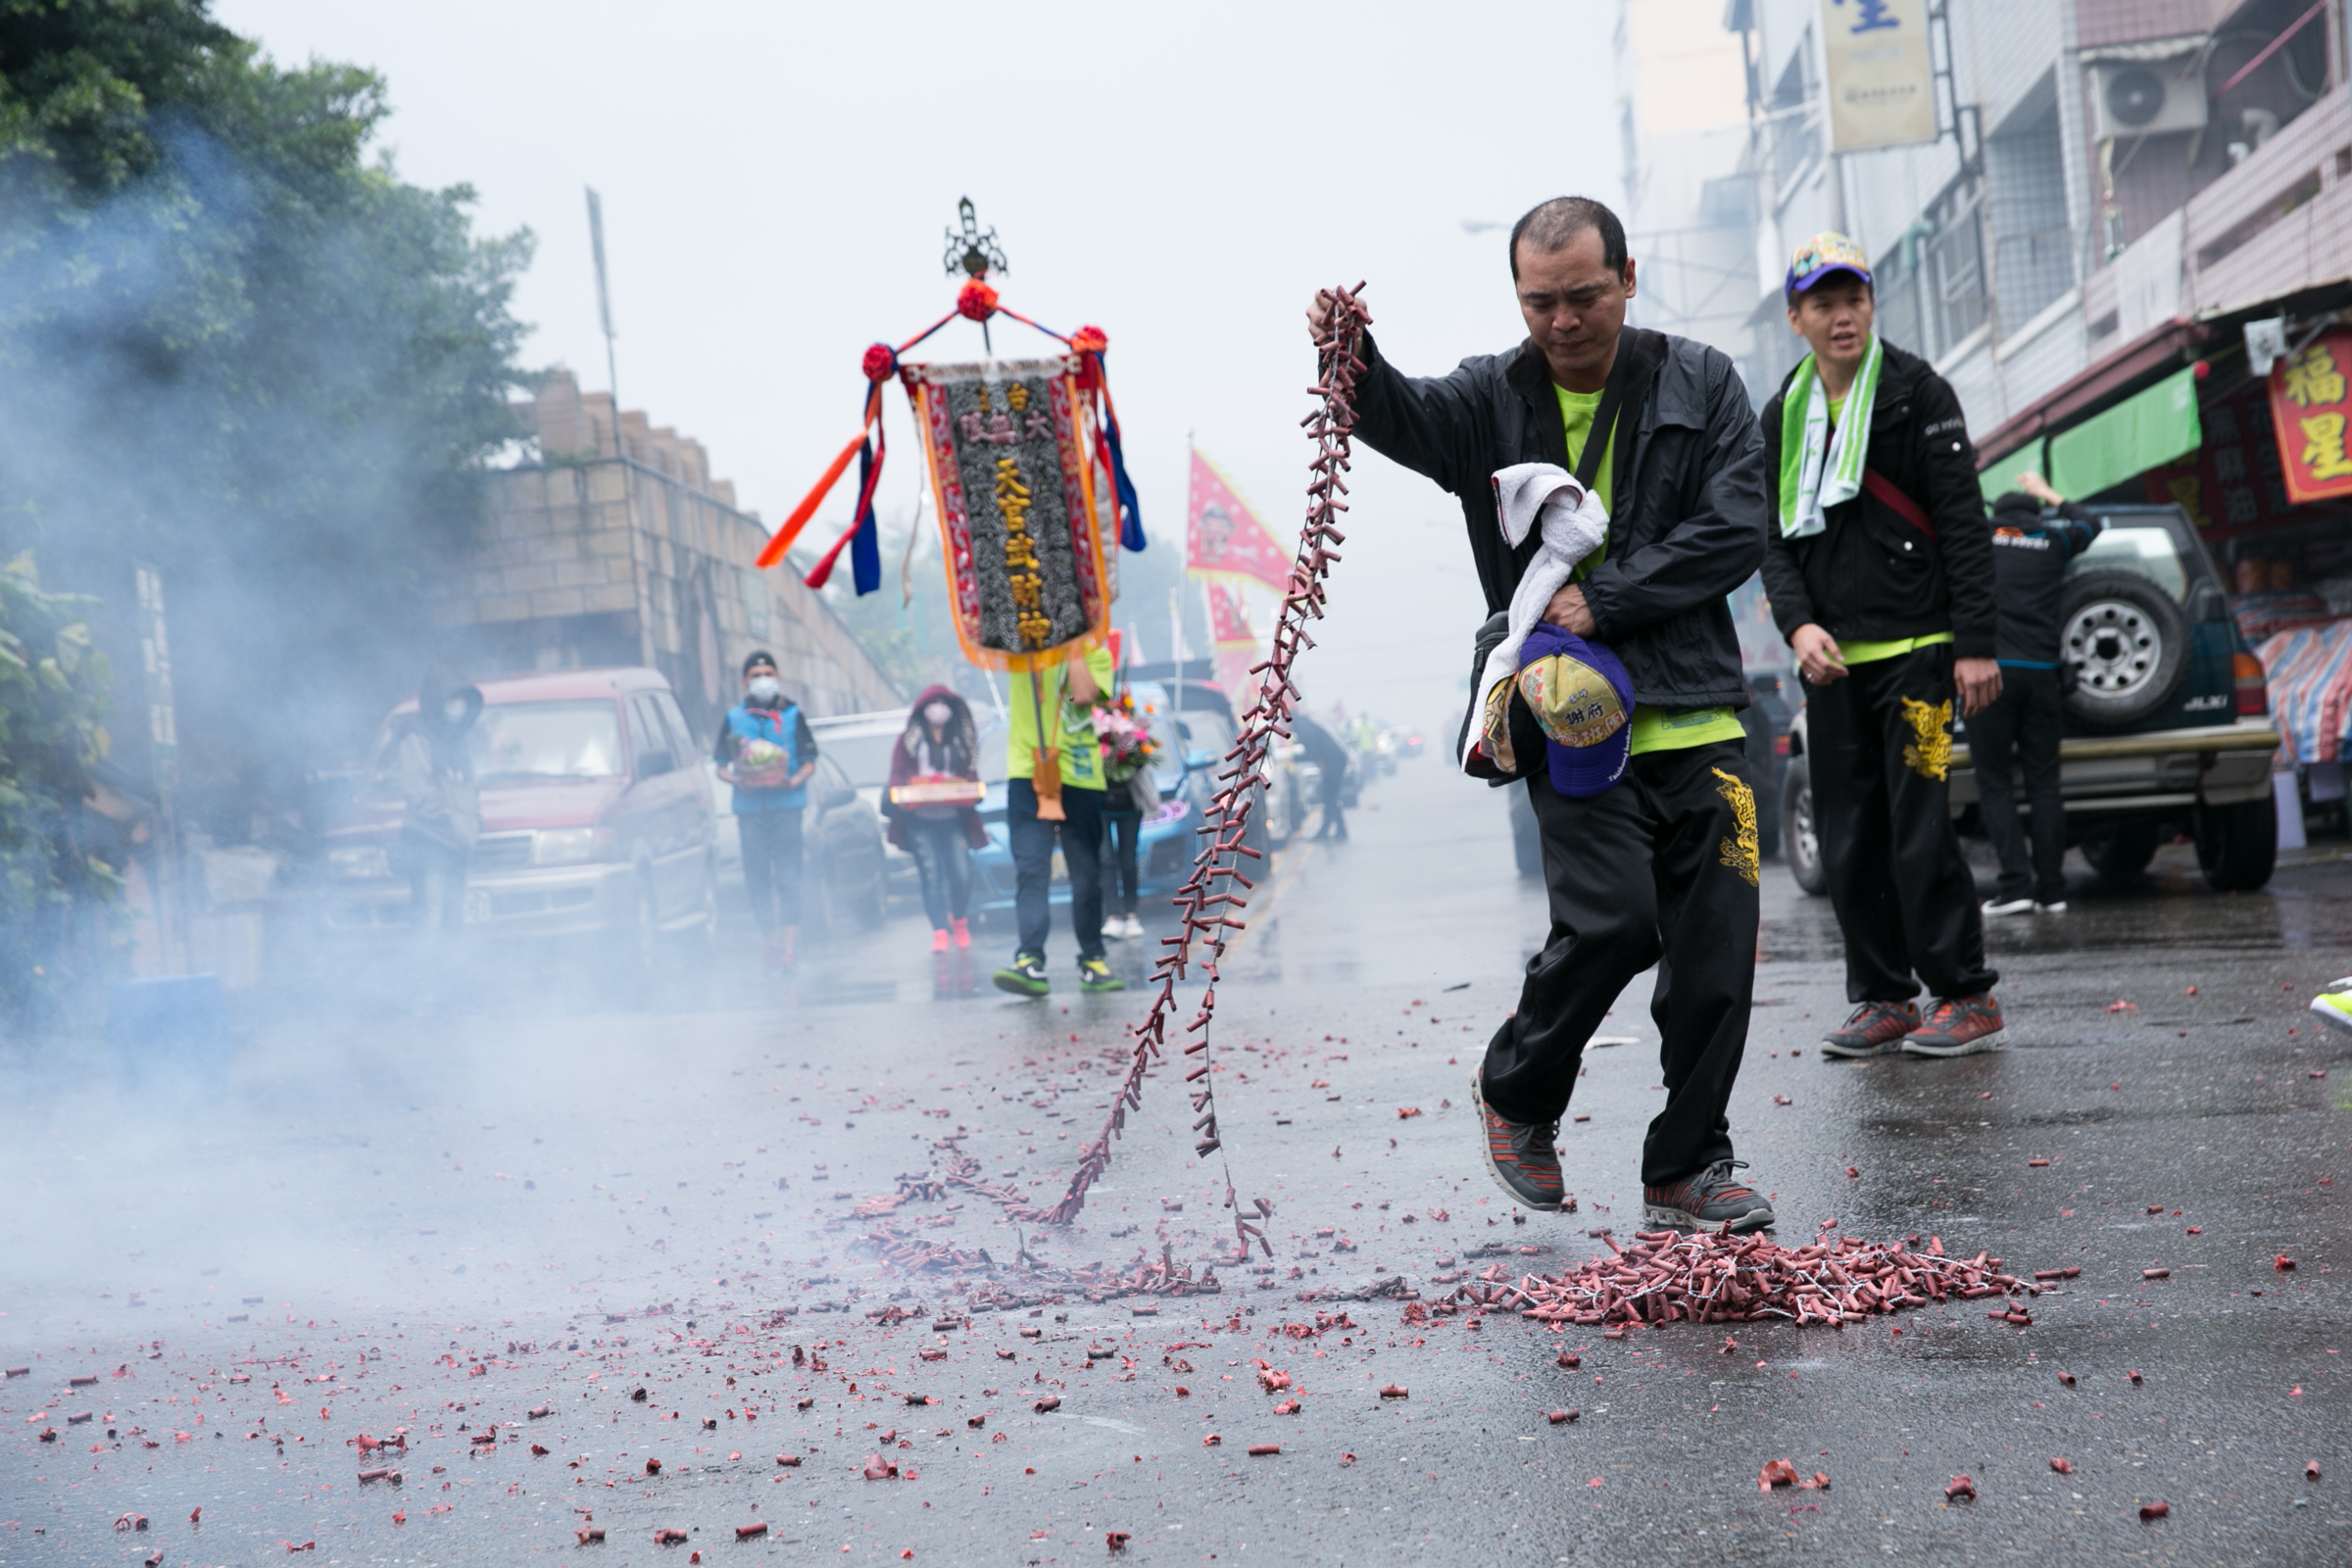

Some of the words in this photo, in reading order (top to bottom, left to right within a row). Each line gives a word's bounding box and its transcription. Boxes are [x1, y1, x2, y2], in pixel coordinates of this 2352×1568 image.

[2284, 344, 2352, 481] 福星
[995, 458, 1052, 649] 天官武財神
[1566, 703, 1603, 724] 謝府
[1608, 752, 1629, 781] Taichung
